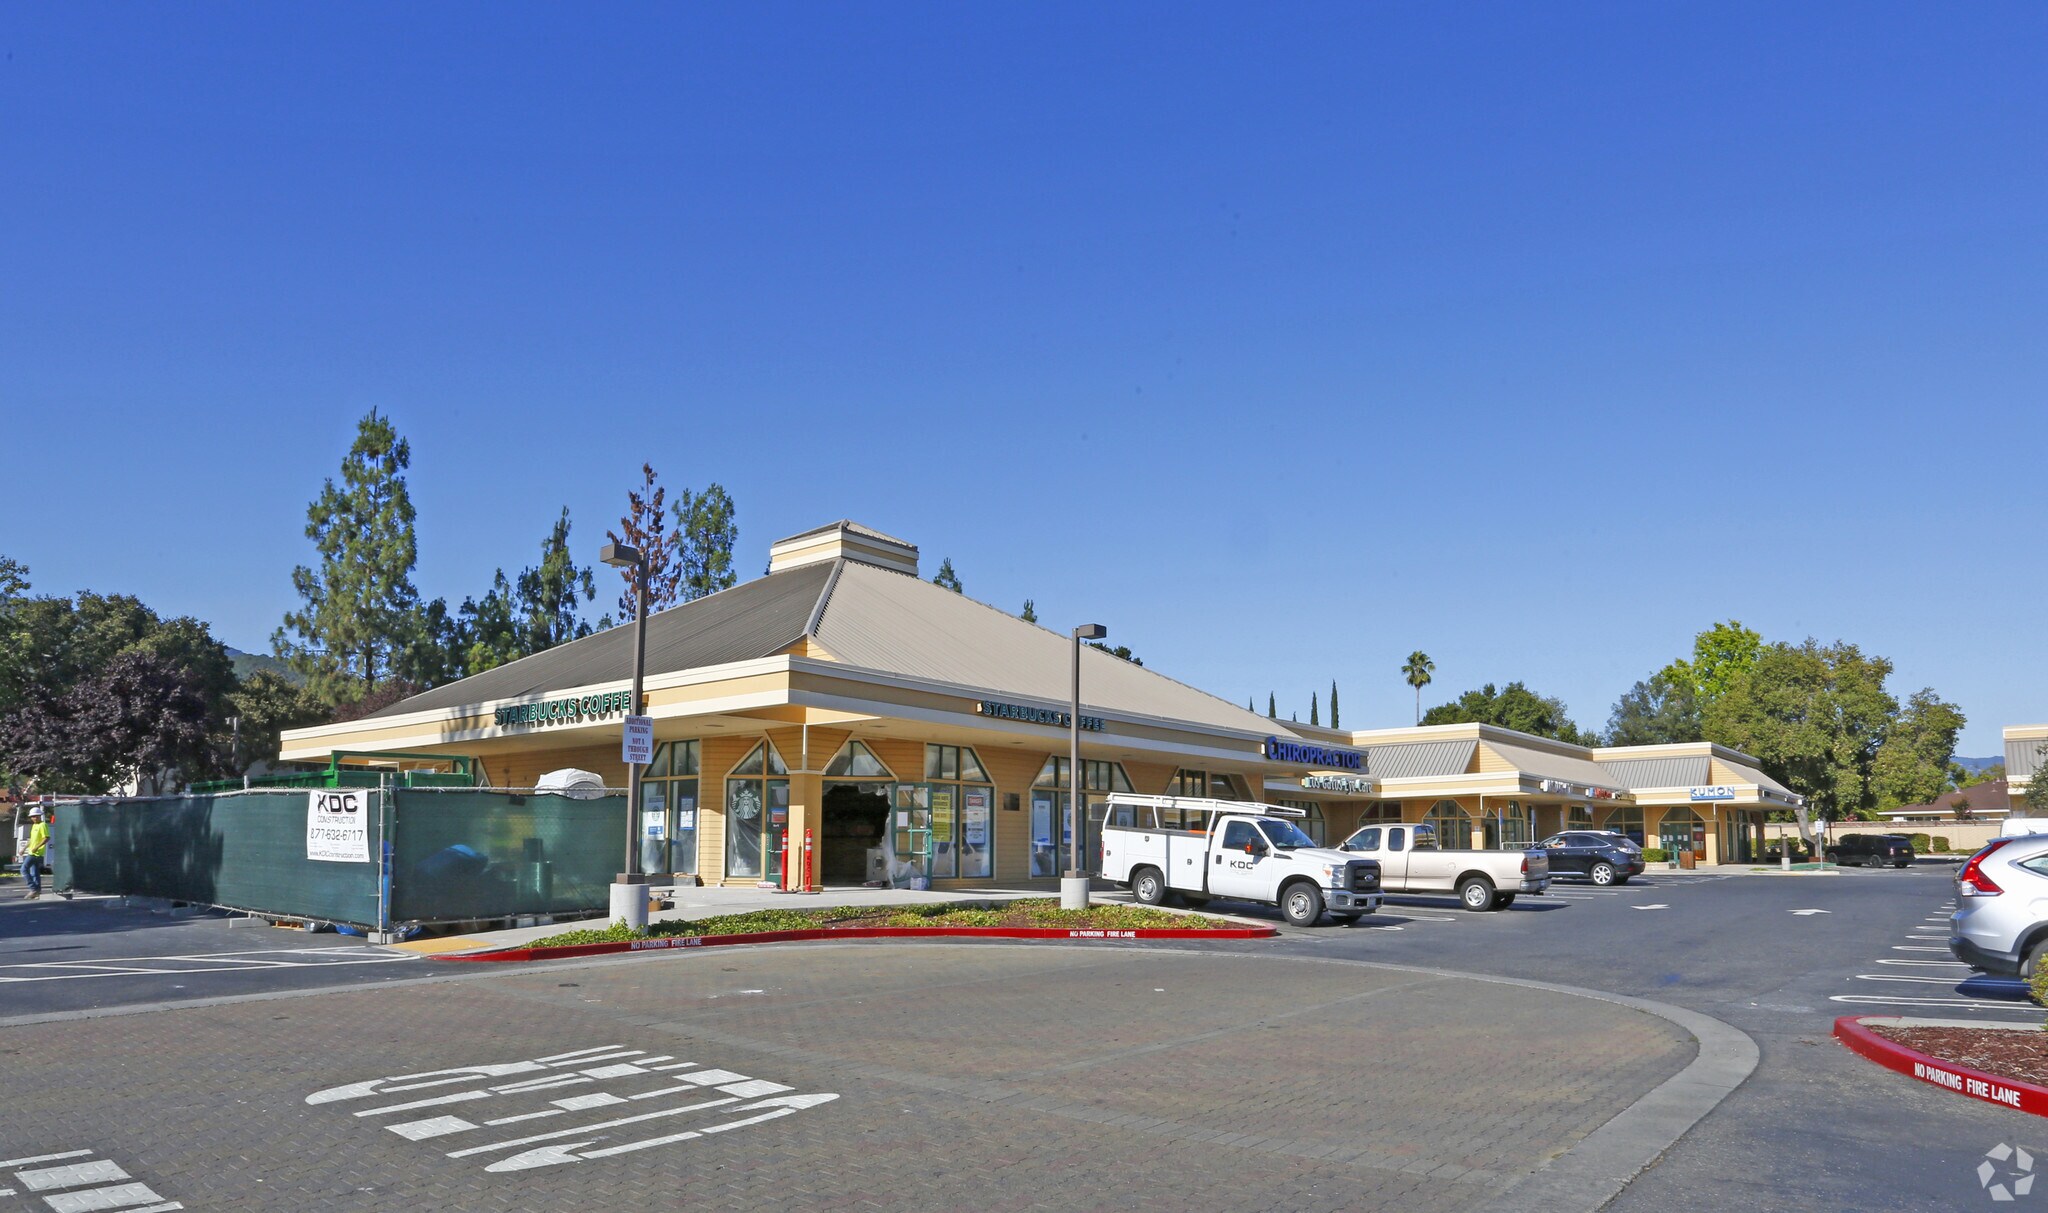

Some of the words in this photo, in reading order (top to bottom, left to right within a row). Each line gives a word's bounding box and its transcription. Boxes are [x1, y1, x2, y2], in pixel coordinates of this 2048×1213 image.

[494, 698, 577, 725] STARBUCKS
[580, 690, 632, 715] COFFE
[983, 700, 1061, 725] STARBUCKS
[1063, 712, 1105, 732] CFFEE
[629, 726, 648, 734] PARKING
[632, 737, 641, 745] NOT
[628, 745, 648, 753] THROUGH
[1265, 735, 1361, 769] CHIROPRACTOR
[1691, 786, 1735, 797] KUMON
[317, 794, 358, 813] KDC
[317, 815, 356, 825] CONSTRUCTION
[310, 828, 363, 841] 877-632-6717
[1230, 860, 1253, 870] KDC
[631, 942, 640, 950] NO
[641, 940, 668, 949] PARKING
[671, 939, 685, 948] FIRE
[686, 938, 702, 946] LANE
[1914, 1062, 1925, 1078] NO
[1926, 1066, 1962, 1090] PARKING
[1966, 1078, 1989, 1098] FIRE
[1991, 1085, 2021, 1107] LANE
